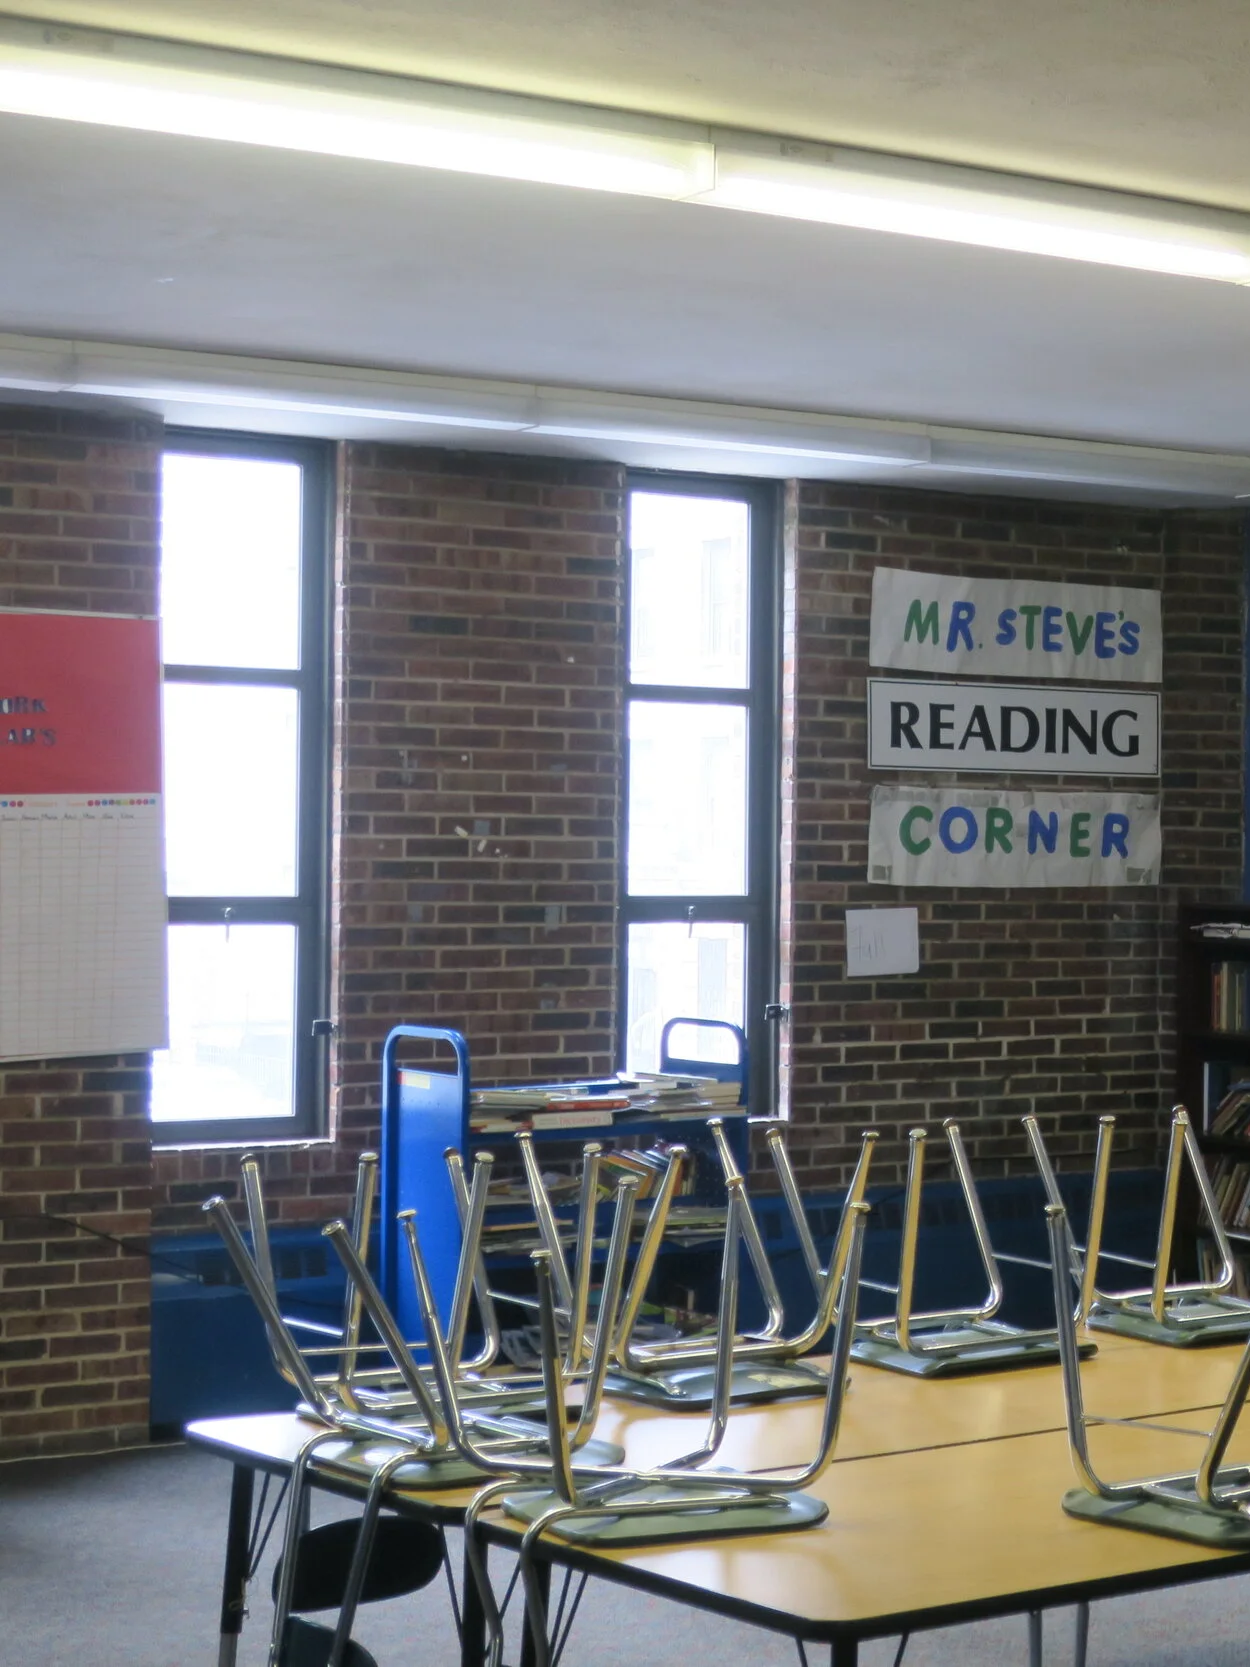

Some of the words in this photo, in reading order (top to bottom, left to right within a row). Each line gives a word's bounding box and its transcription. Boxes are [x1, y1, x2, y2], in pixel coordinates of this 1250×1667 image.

[904, 599, 983, 653] MR.
[995, 605, 1141, 659] STEVE'S
[889, 700, 1140, 757] READING
[898, 805, 1131, 858] CORNER
